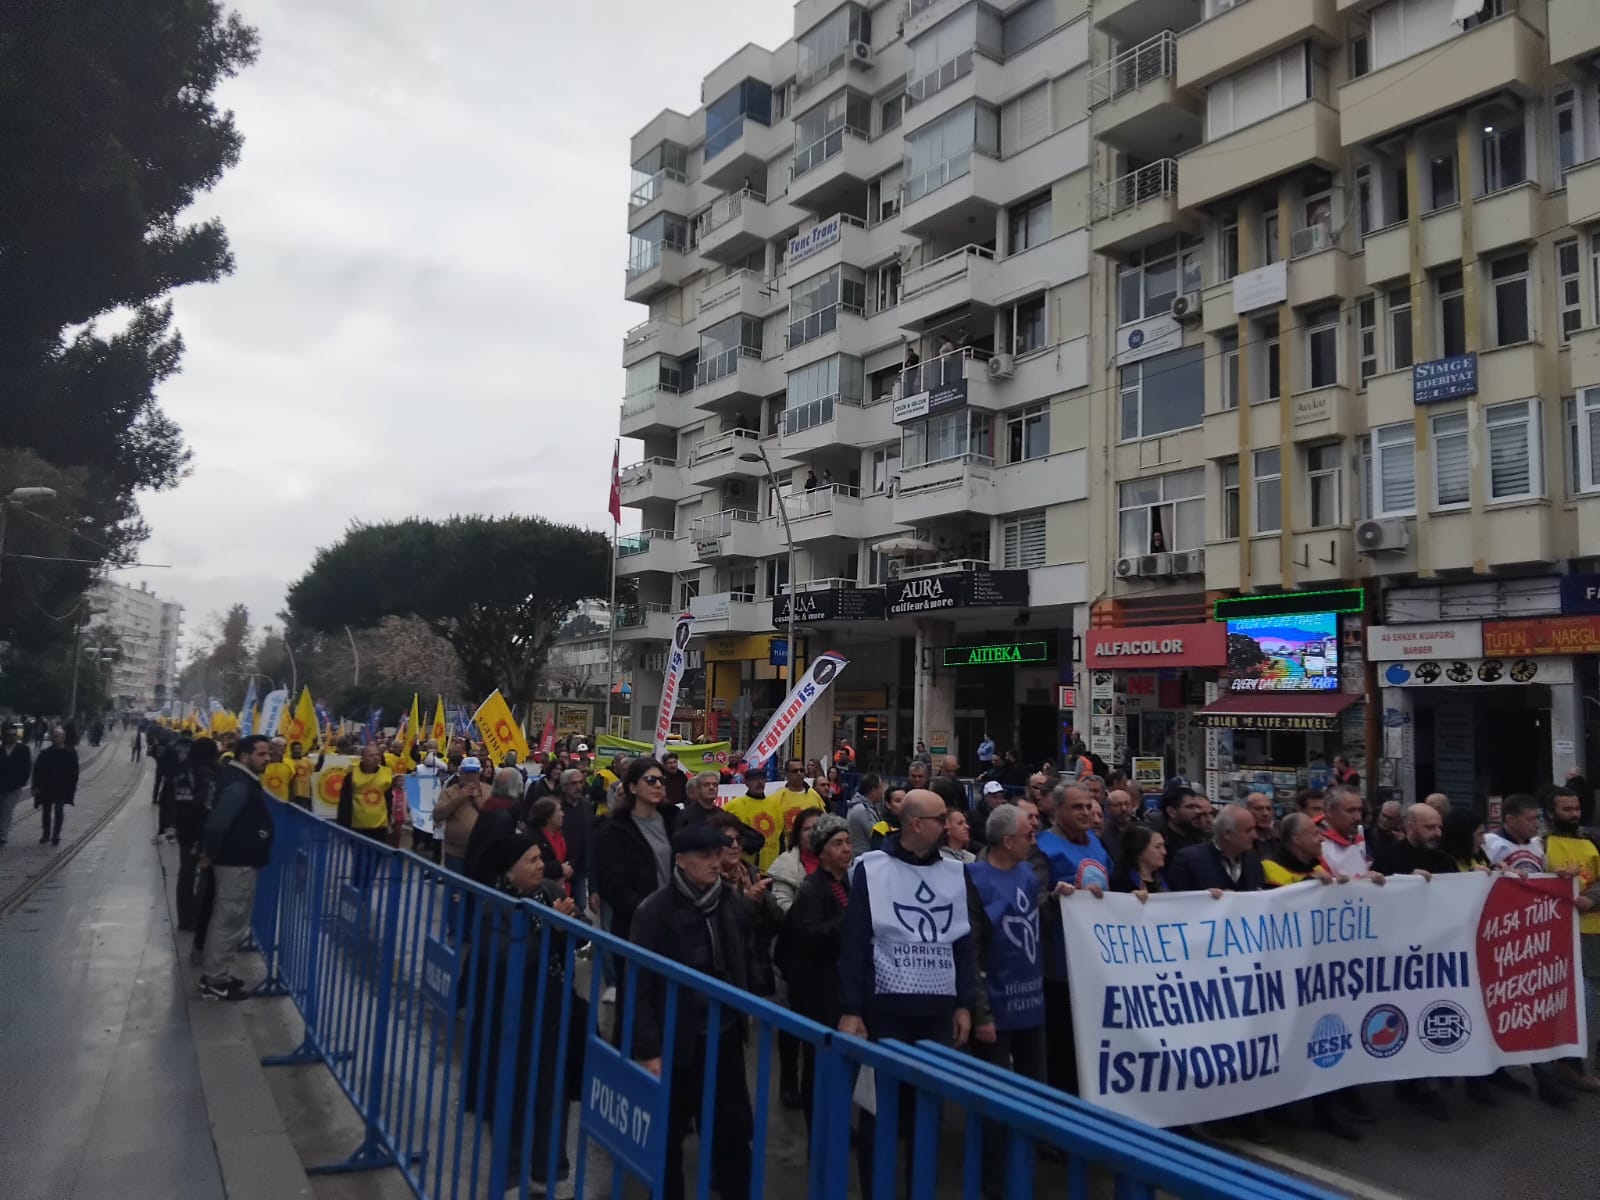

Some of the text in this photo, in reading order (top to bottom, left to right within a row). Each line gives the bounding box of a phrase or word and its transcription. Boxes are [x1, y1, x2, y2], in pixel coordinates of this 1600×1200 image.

[812, 219, 838, 243] Trans
[1416, 370, 1473, 389] EDEBİYAT
[899, 577, 944, 602] AURA
[1094, 639, 1184, 657] ALFACOLOR
[1393, 632, 1418, 642] ERKEK
[1403, 645, 1433, 655] BARBER
[968, 645, 1022, 662] АПТЕКА
[1257, 716, 1281, 728] LIFE
[1287, 717, 1328, 728] TRAVEL
[1093, 897, 1378, 964] SEFALET ZAMMI DEĞİL
[1483, 896, 1562, 941] 11.54 TÜİK
[894, 957, 936, 969] EĞİTİM
[1494, 930, 1552, 977] YALANI
[1102, 944, 1471, 1030] EMEĞİMİZİN KARŞILIĞINI
[1485, 955, 1569, 1009] EMEKÇİNİN
[1497, 987, 1569, 1034] DÜŞMANI
[1306, 1032, 1353, 1060] KESK
[1099, 1033, 1280, 1095] İSTİYORUZ!
[632, 1107, 650, 1148] 07
